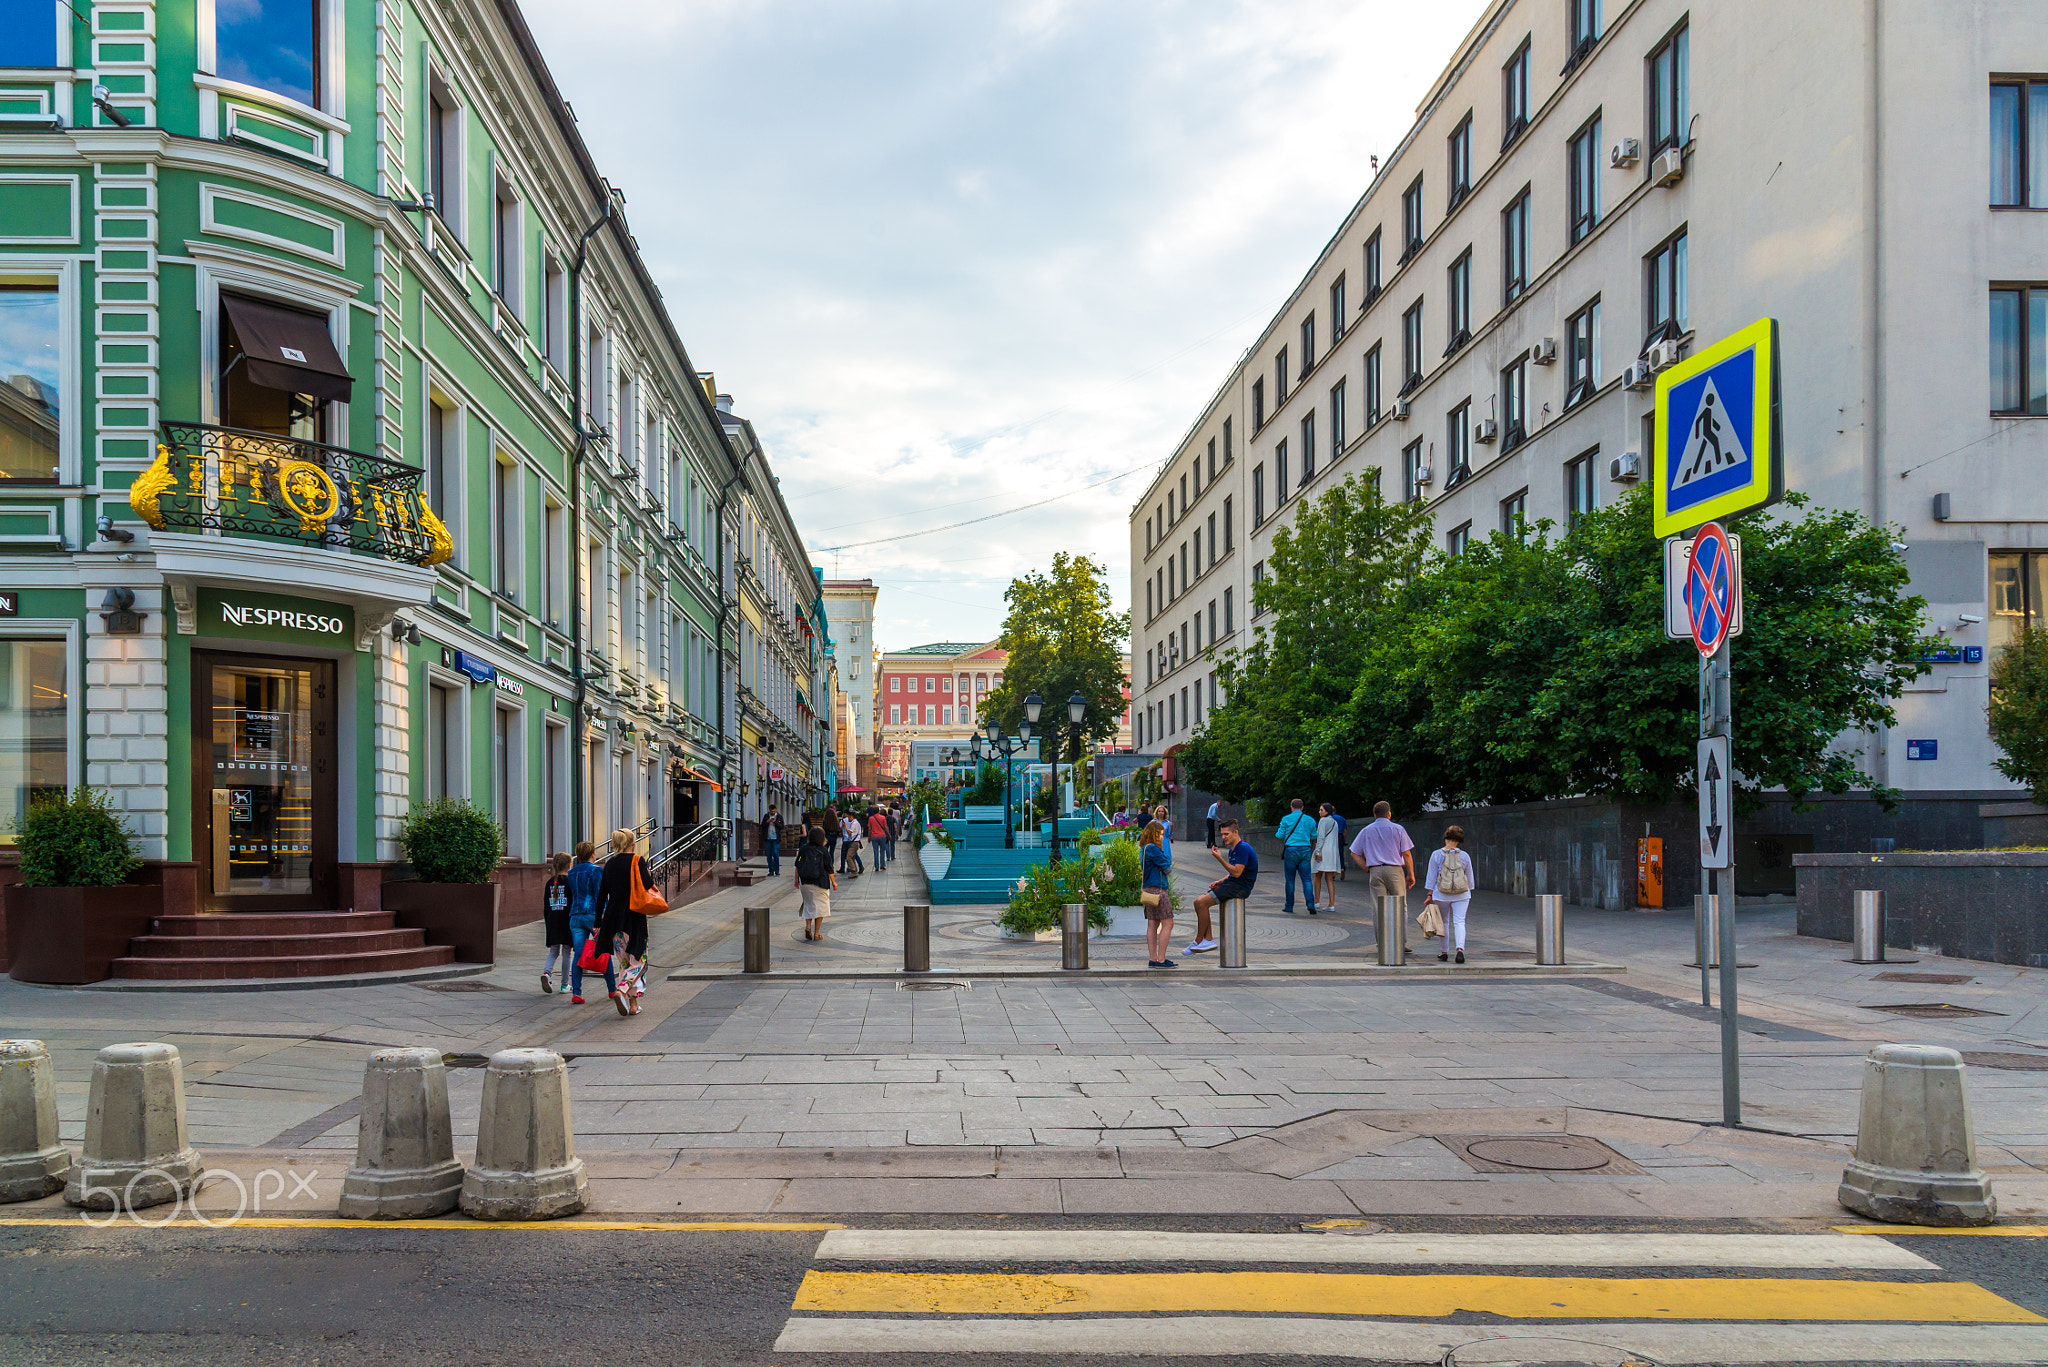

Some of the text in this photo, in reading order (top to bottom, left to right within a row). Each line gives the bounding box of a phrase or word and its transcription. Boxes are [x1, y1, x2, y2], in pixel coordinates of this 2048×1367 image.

[220, 601, 343, 634] NESPRESSO
[1970, 650, 1979, 658] 15
[496, 671, 523, 696] NESPRESSO
